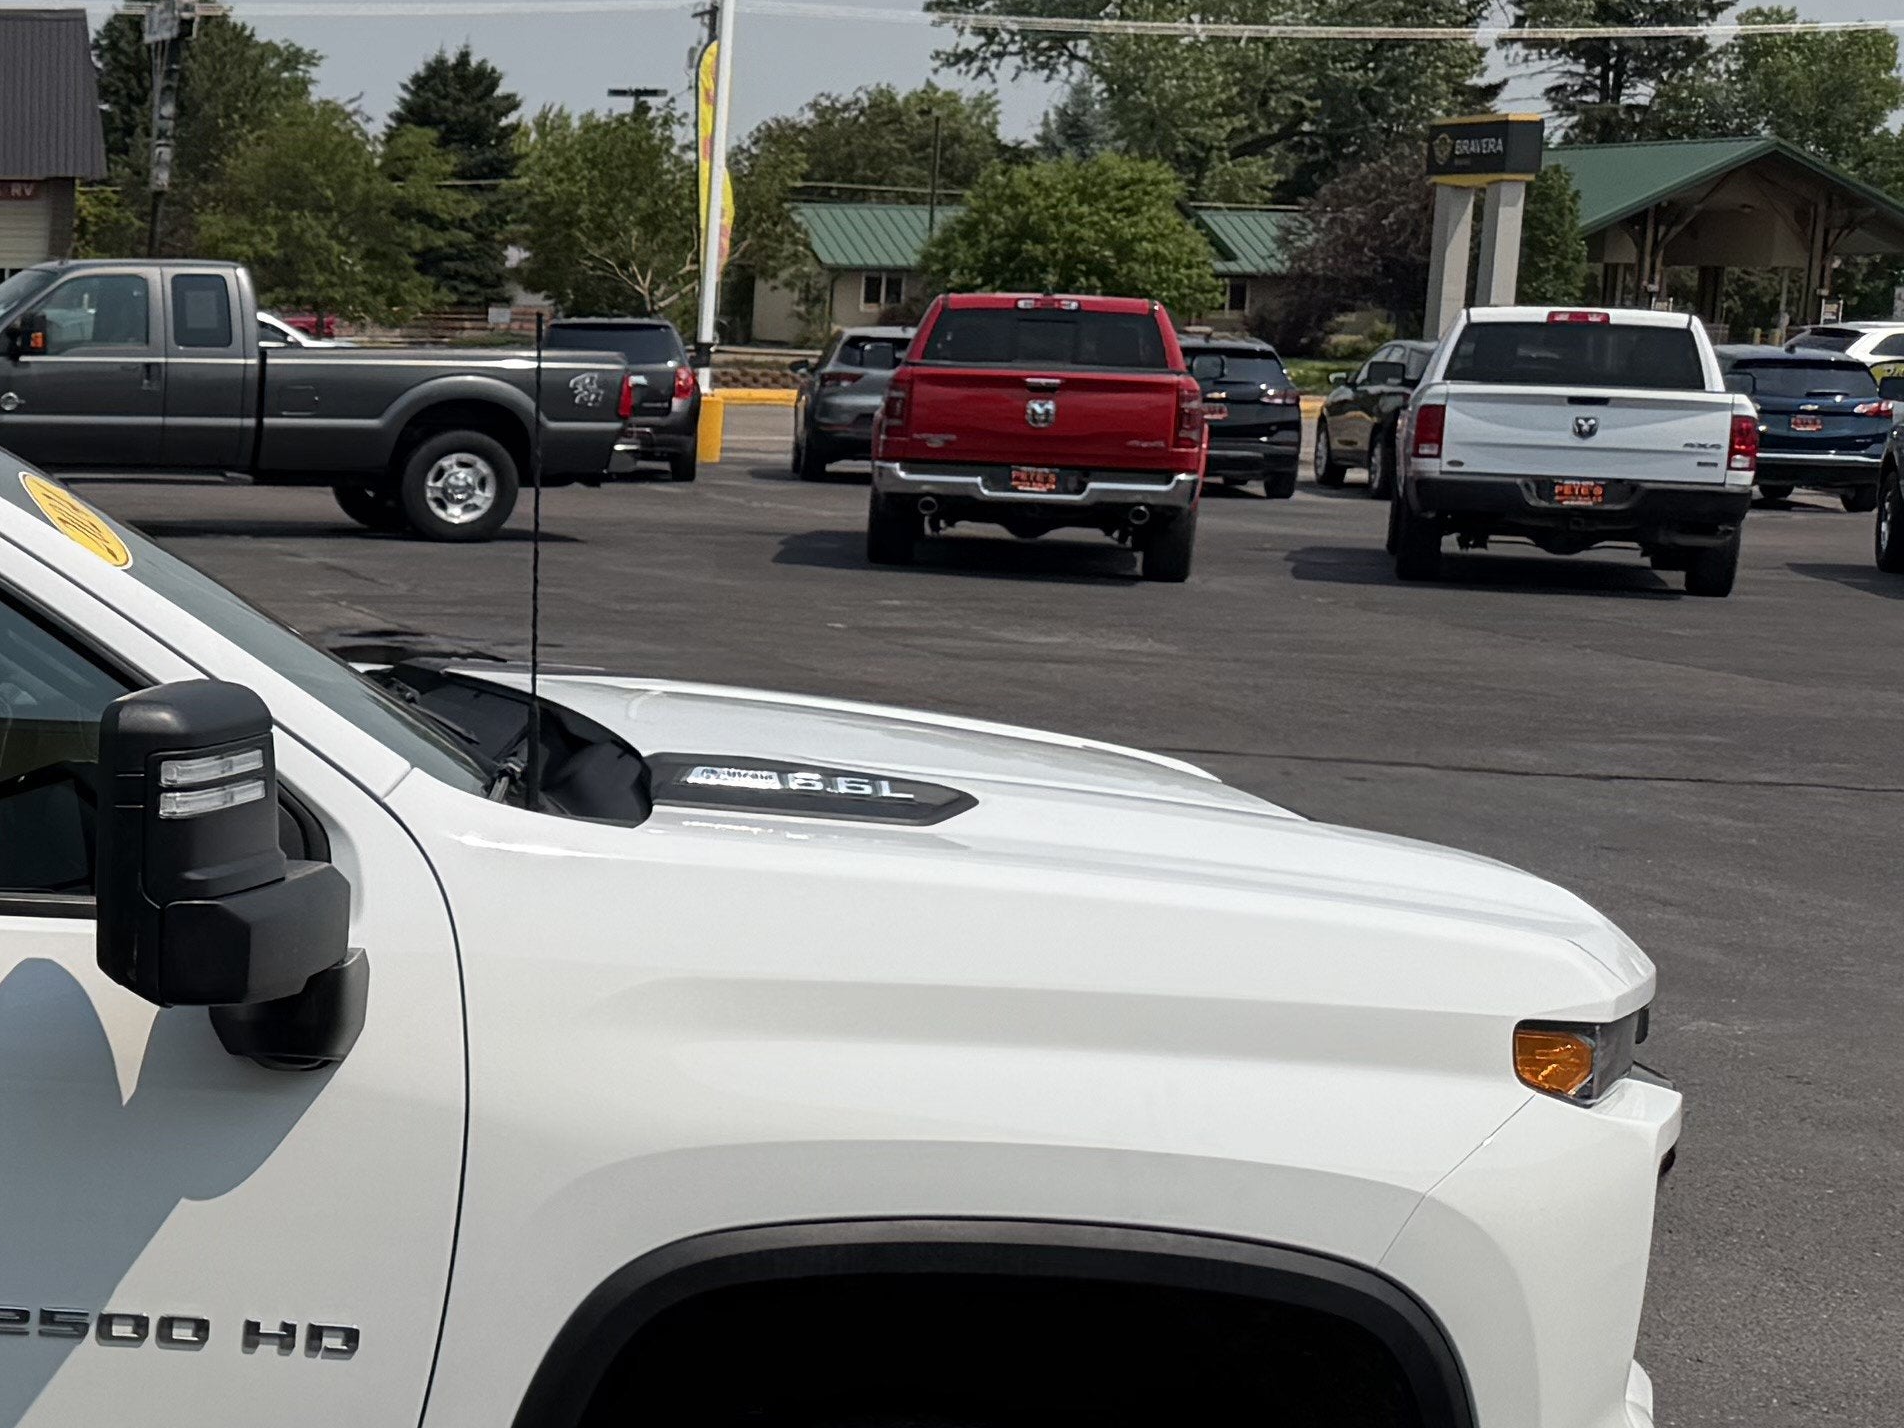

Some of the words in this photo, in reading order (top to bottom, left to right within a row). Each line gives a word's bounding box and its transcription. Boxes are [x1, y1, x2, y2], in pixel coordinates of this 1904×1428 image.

[1454, 138, 1504, 155] BRAVERA
[11, 182, 34, 197] RV
[787, 771, 914, 799] 6.6L
[241, 1318, 361, 1360] HD
